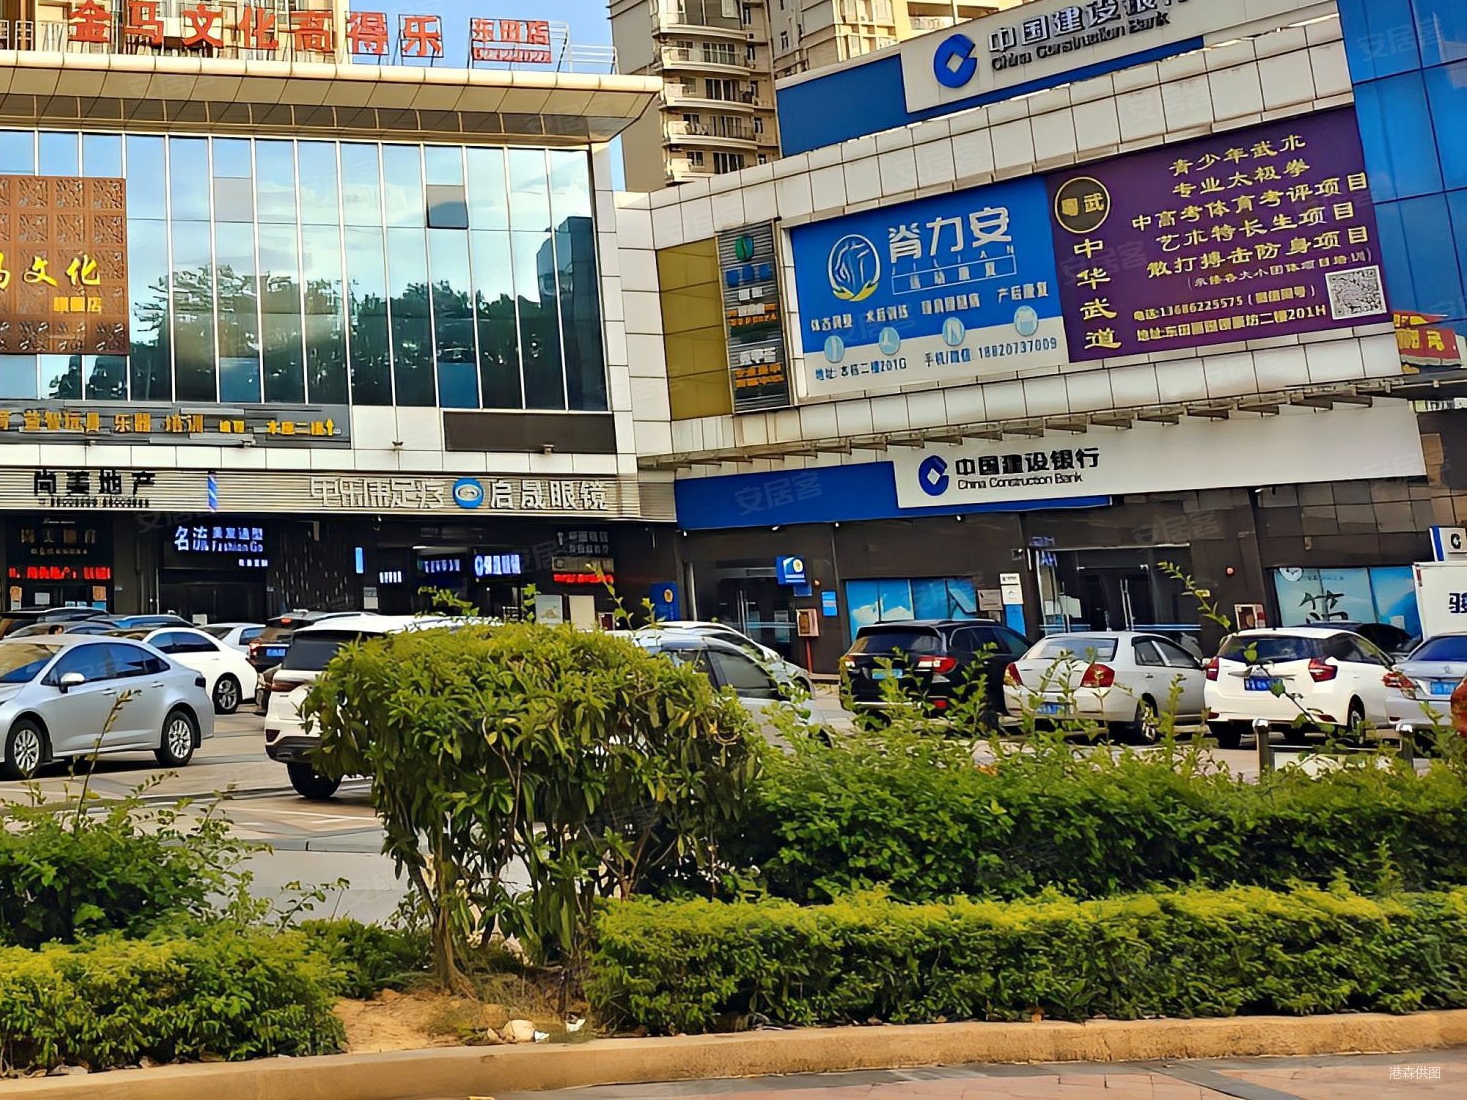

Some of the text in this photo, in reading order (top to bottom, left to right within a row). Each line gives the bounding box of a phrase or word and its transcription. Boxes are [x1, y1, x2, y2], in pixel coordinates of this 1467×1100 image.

[68, 0, 441, 57] 金马文化高得乐
[991, 50, 1033, 72] China
[1168, 133, 1307, 177] 青少年武术
[1172, 158, 1311, 199] 专业太极拳
[1131, 171, 1368, 232] 中高考体育考评项目
[888, 206, 1012, 264] 脊力安
[1156, 200, 1355, 252] 艺术特长生项目
[1146, 225, 1369, 279] 散打搏击防身项目
[1072, 237, 1122, 351] 中华武道
[34, 468, 156, 496] 尚美地产
[955, 446, 1100, 476] 中国建设银行
[174, 525, 210, 552] 名流
